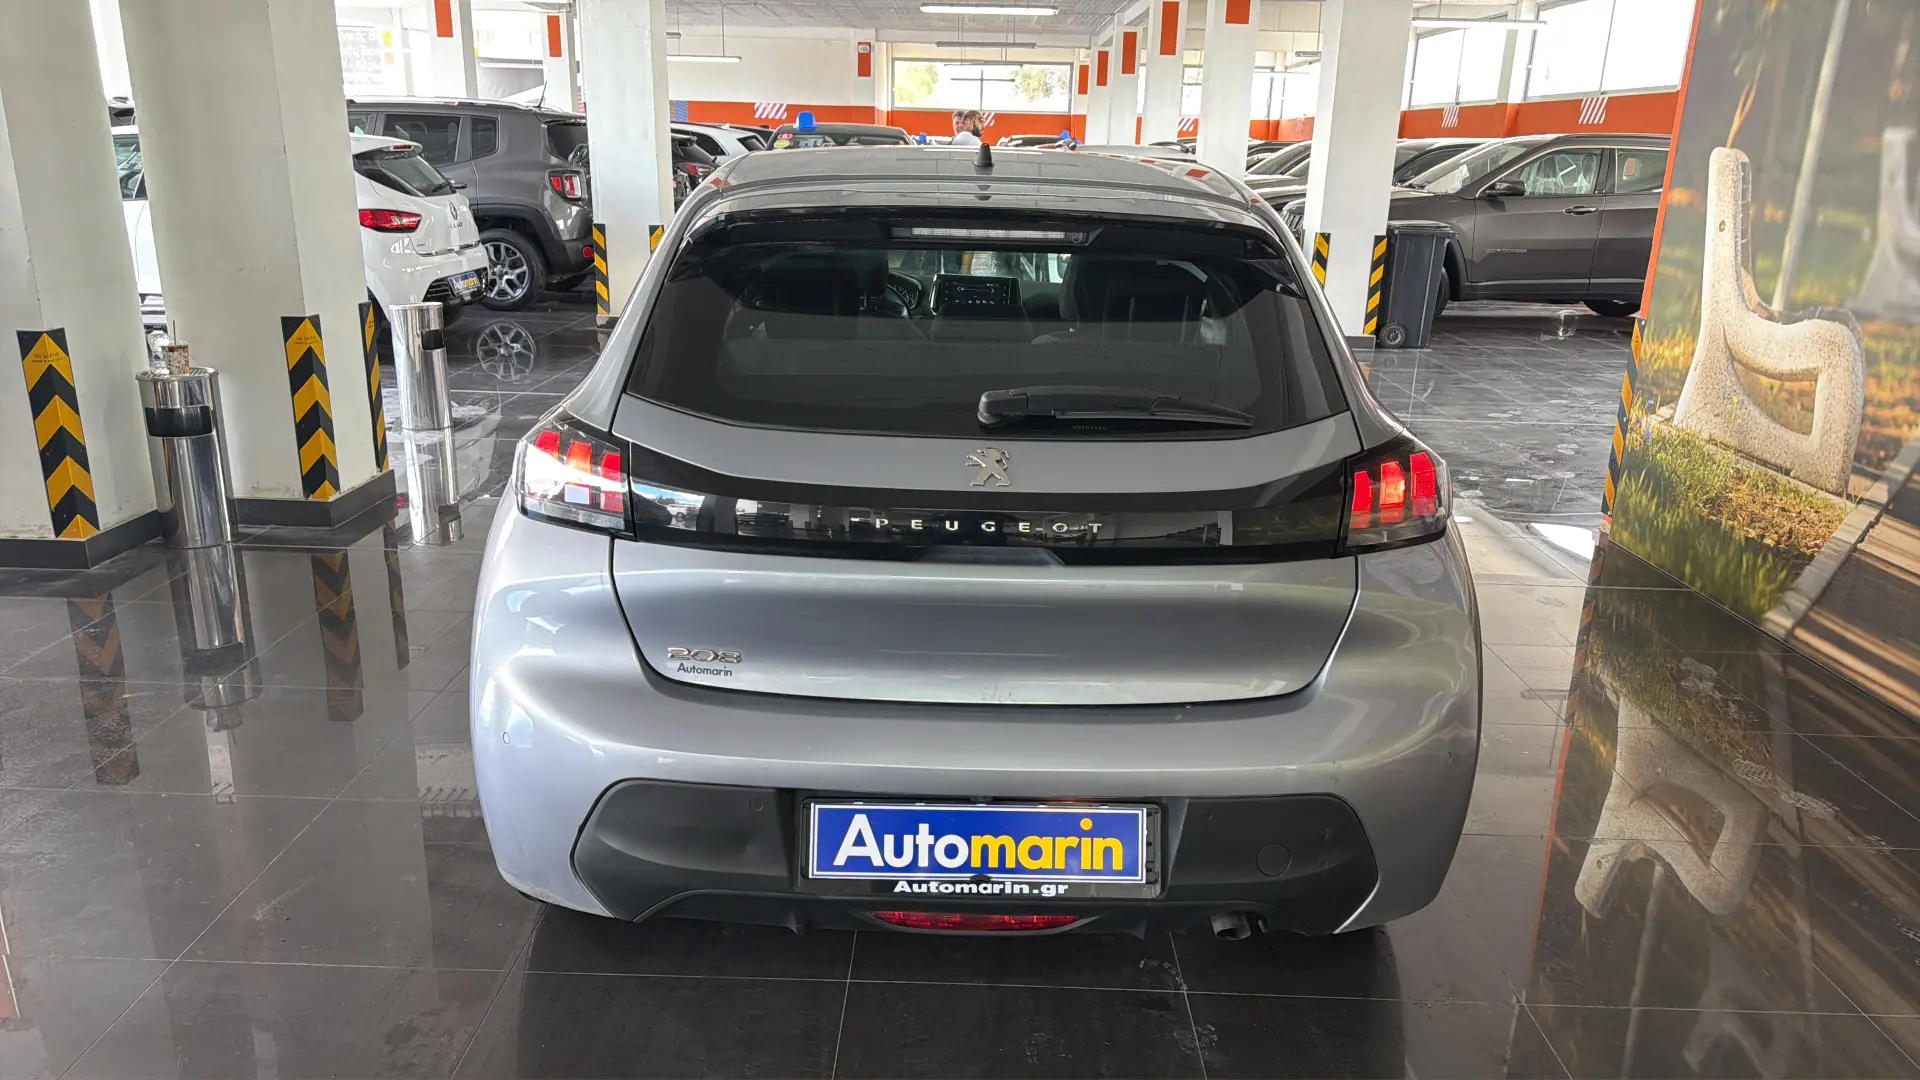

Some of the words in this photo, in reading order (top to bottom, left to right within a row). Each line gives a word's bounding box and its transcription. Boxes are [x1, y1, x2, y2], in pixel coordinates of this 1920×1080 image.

[875, 518, 1102, 533] PEUGEOT
[667, 647, 742, 663] 208
[677, 662, 733, 677] Automarin
[832, 813, 1123, 871] Automarin
[893, 880, 1069, 897] Automarin.gr
